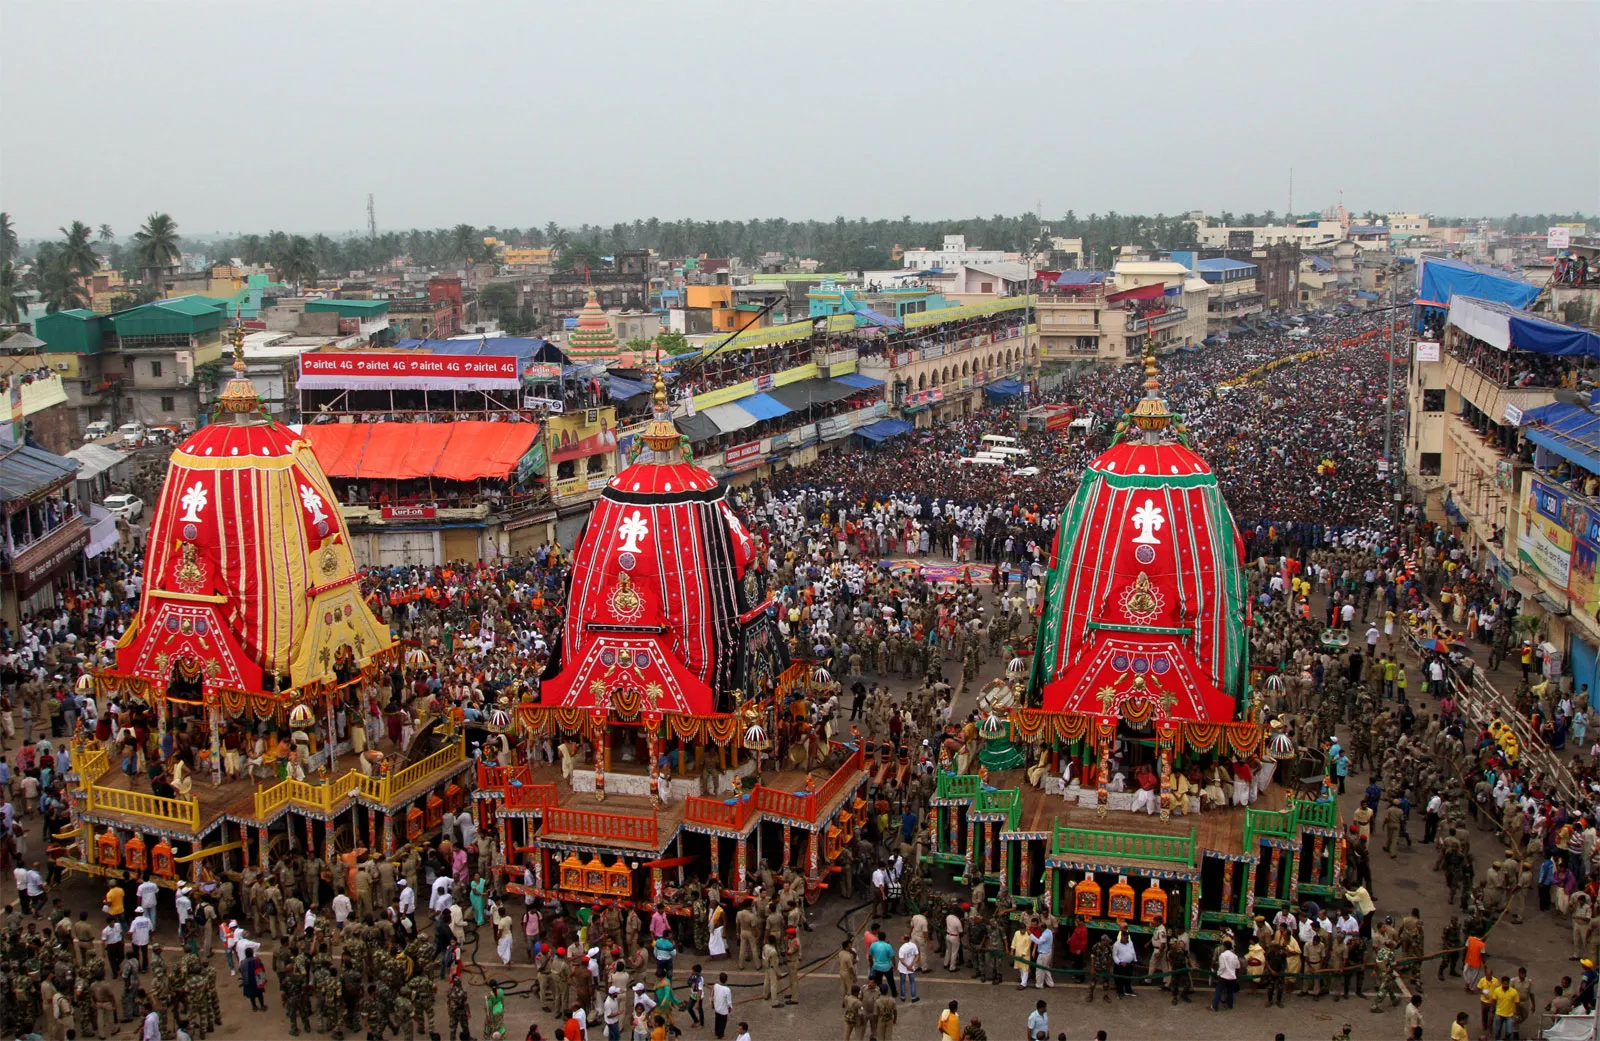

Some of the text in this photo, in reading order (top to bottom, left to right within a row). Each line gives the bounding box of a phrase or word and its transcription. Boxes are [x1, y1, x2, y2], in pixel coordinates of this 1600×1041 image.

[313, 360, 353, 370] airtel 4G
[366, 360, 406, 371] airtel 4G
[419, 361, 460, 371] airtel 4G
[473, 362, 514, 373] airtel 4G
[1546, 496, 1557, 513] SBI
